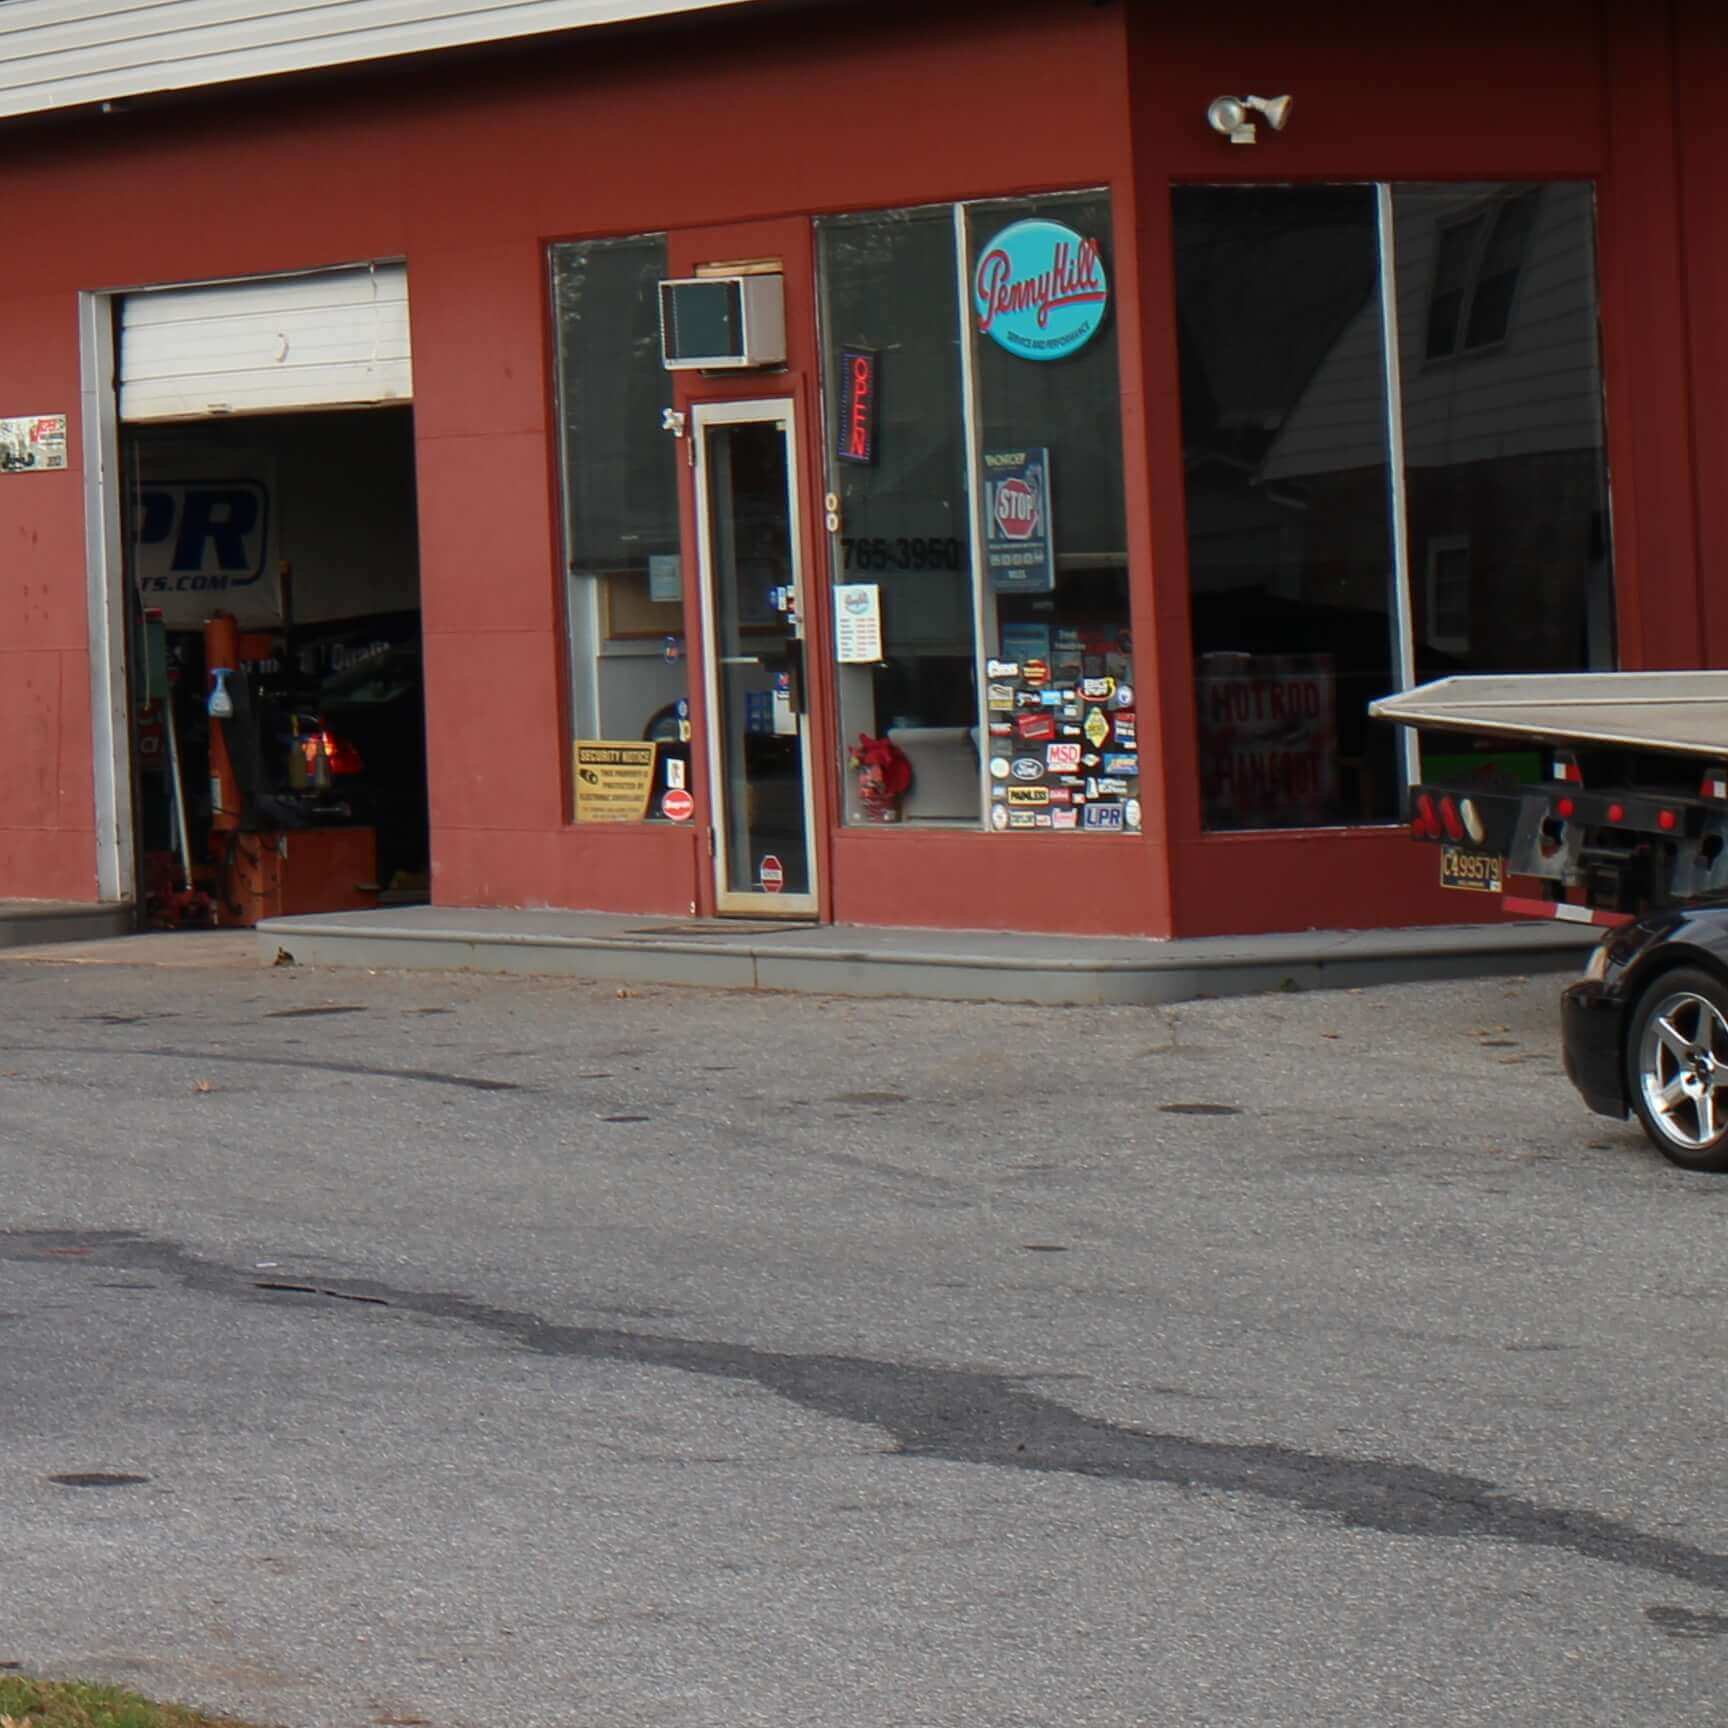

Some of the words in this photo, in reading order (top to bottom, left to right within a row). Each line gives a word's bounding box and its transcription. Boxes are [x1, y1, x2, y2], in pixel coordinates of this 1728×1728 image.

[850, 357, 869, 456] OPEN
[999, 489, 1035, 521] STOP
[1049, 745, 1078, 762] MSD
[1087, 808, 1121, 825] LPR
